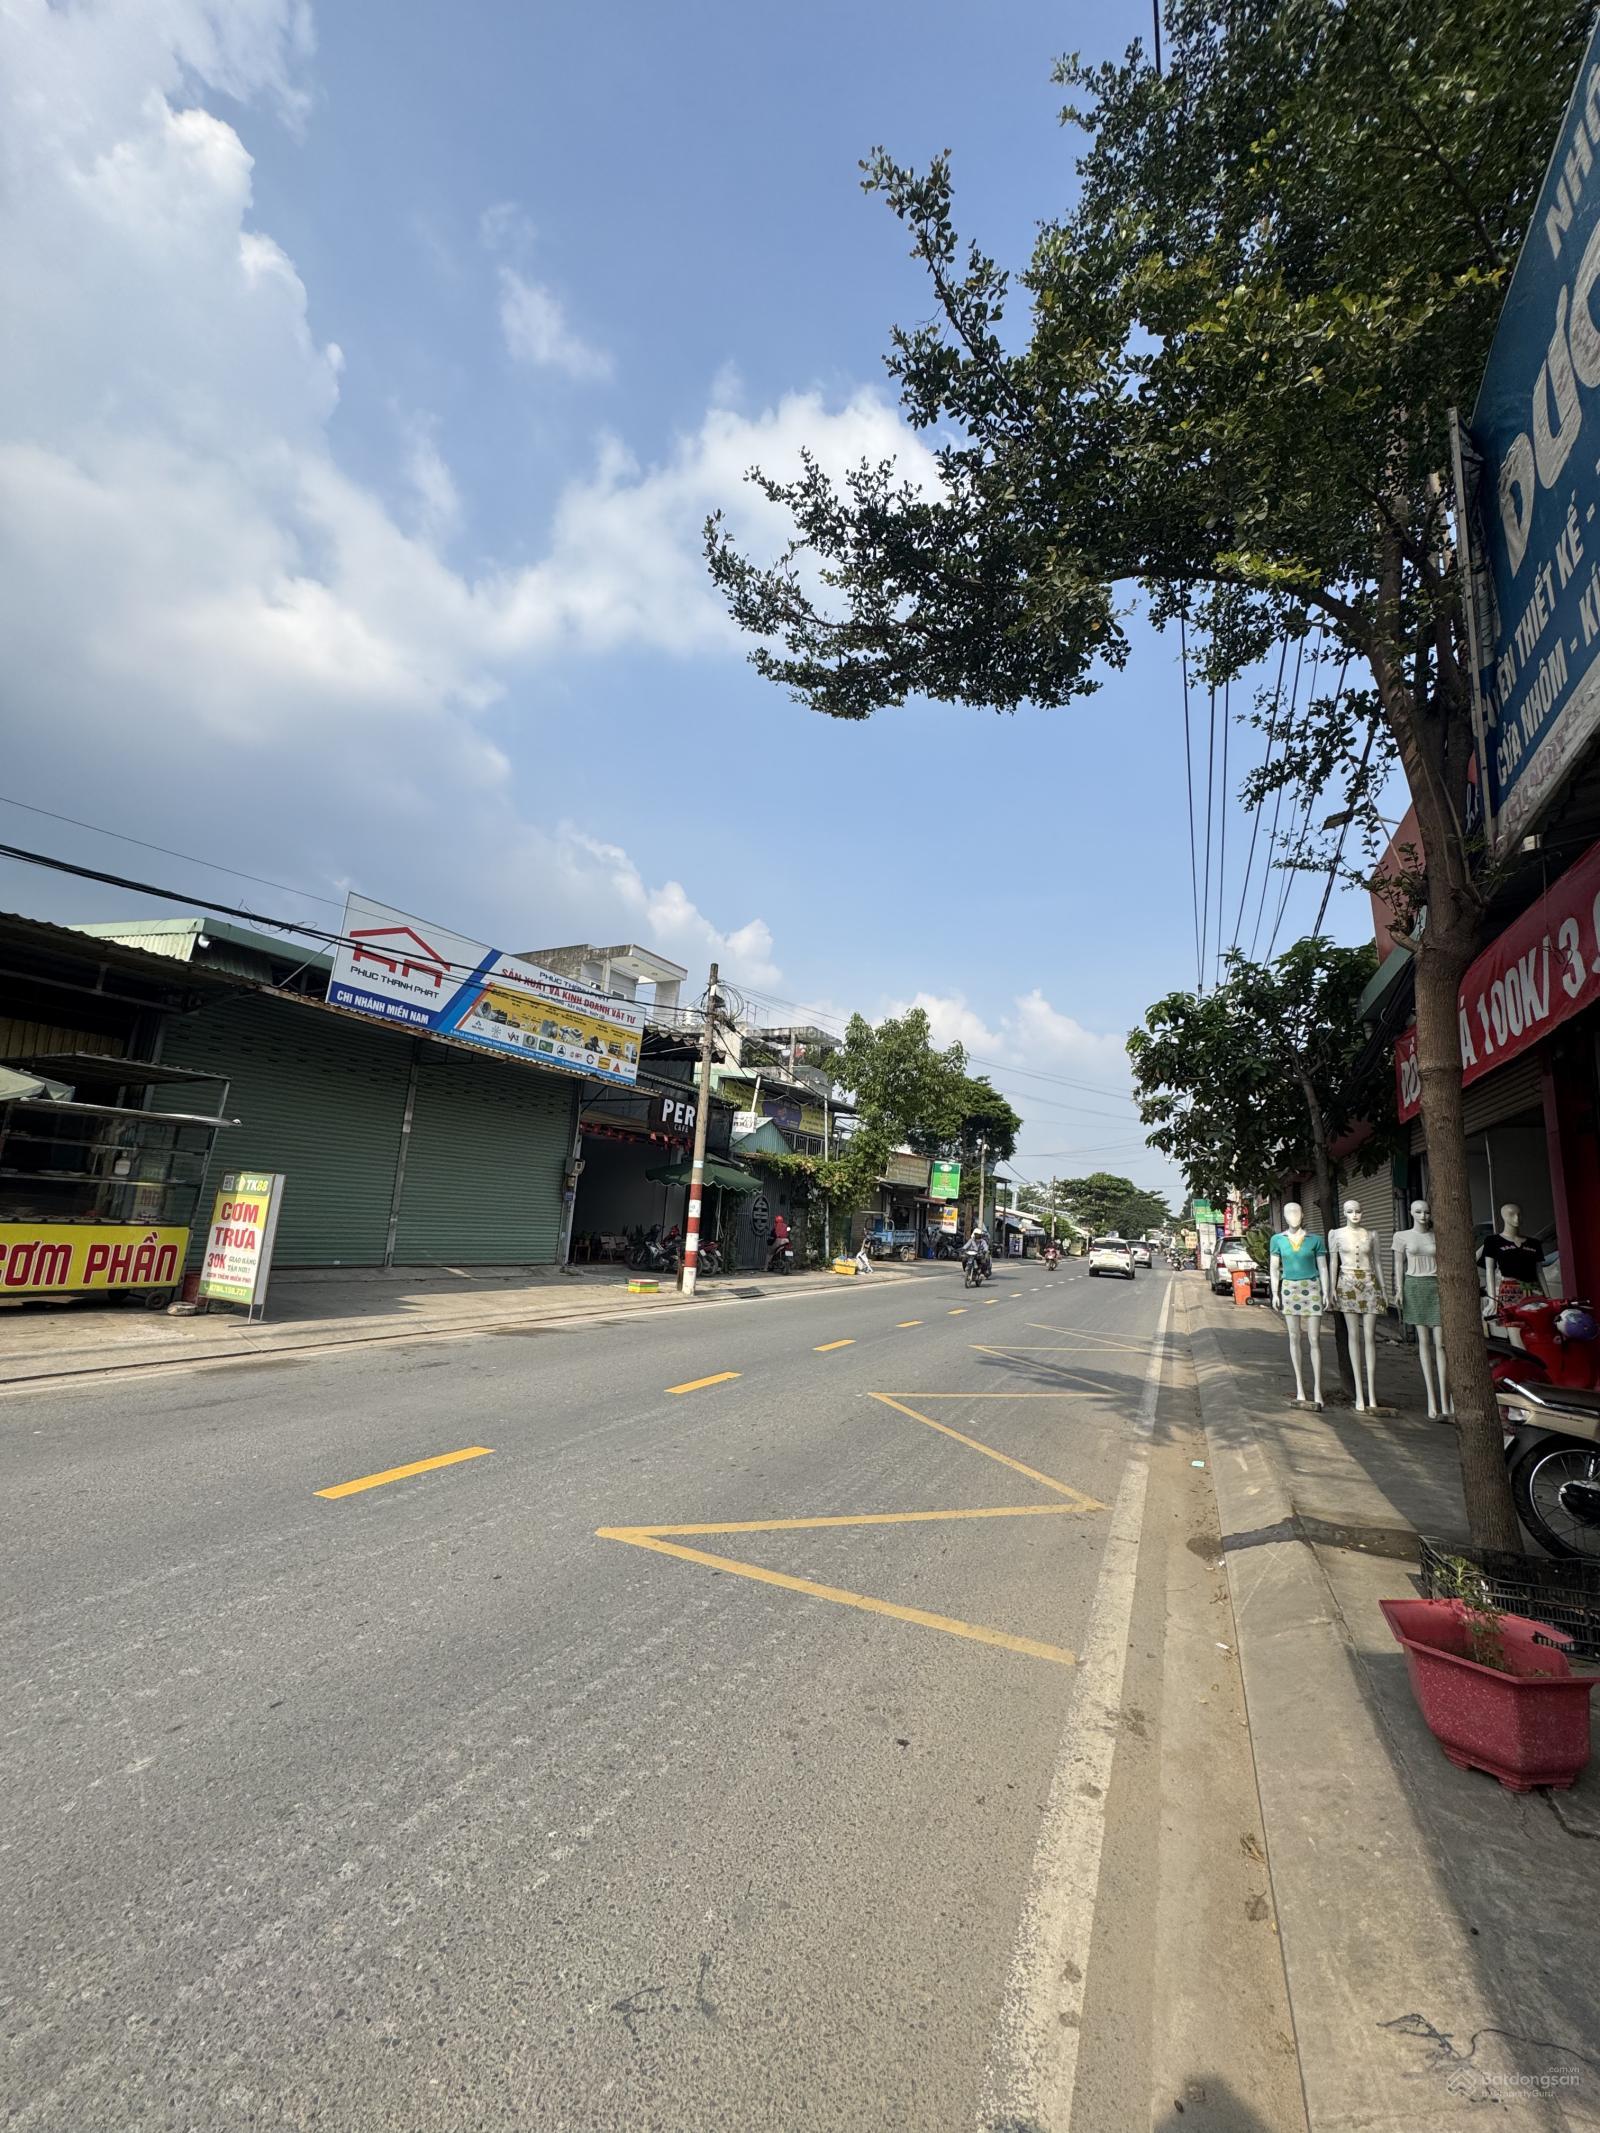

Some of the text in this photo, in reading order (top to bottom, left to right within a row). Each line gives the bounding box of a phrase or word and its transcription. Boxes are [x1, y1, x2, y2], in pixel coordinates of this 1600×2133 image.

[1515, 561, 1556, 668] THIẾT
[1555, 488, 1584, 589] KẾ
[1497, 720, 1522, 787] CỬA
[1520, 637, 1568, 747] NHÔM
[1579, 558, 1600, 647] KÍ
[337, 990, 353, 1004] CHI
[354, 995, 386, 1013] NHÁNH
[410, 1011, 429, 1024] NAM
[562, 991, 583, 1004] KINH
[584, 999, 610, 1015] DOANH
[611, 1006, 625, 1020] VẬT
[661, 1098, 696, 1128] PER
[221, 1202, 259, 1223] CƠM
[215, 1227, 256, 1250] TRƯA
[82, 1231, 179, 1285] PHẦN
[207, 1253, 227, 1269] 30K
